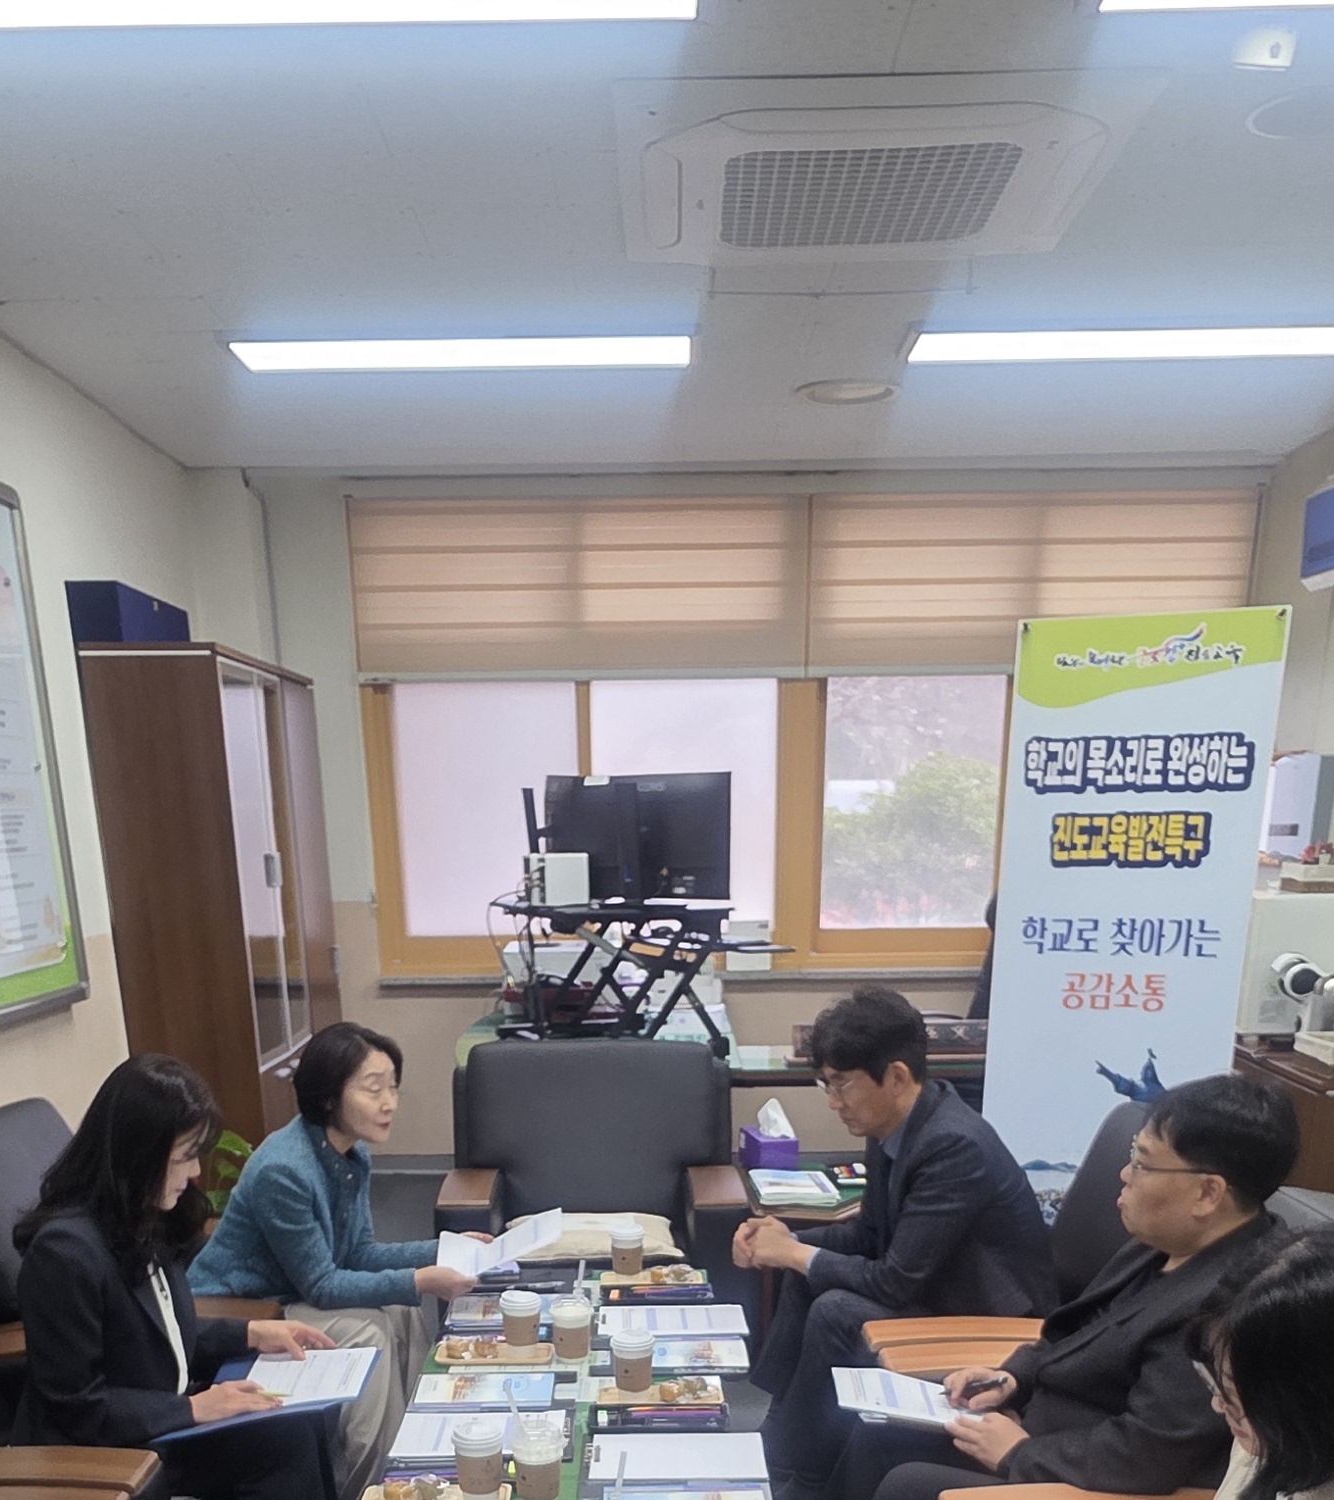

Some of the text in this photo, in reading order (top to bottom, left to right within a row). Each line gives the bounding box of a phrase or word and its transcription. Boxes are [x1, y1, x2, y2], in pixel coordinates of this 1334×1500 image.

[1027, 734, 1248, 787] 학교의 목소리로 완성하는
[1052, 814, 1205, 861] 진도교육발전특구
[1021, 916, 1222, 959] 학교로 찾아가는
[1061, 972, 1166, 1012] 공감소통
